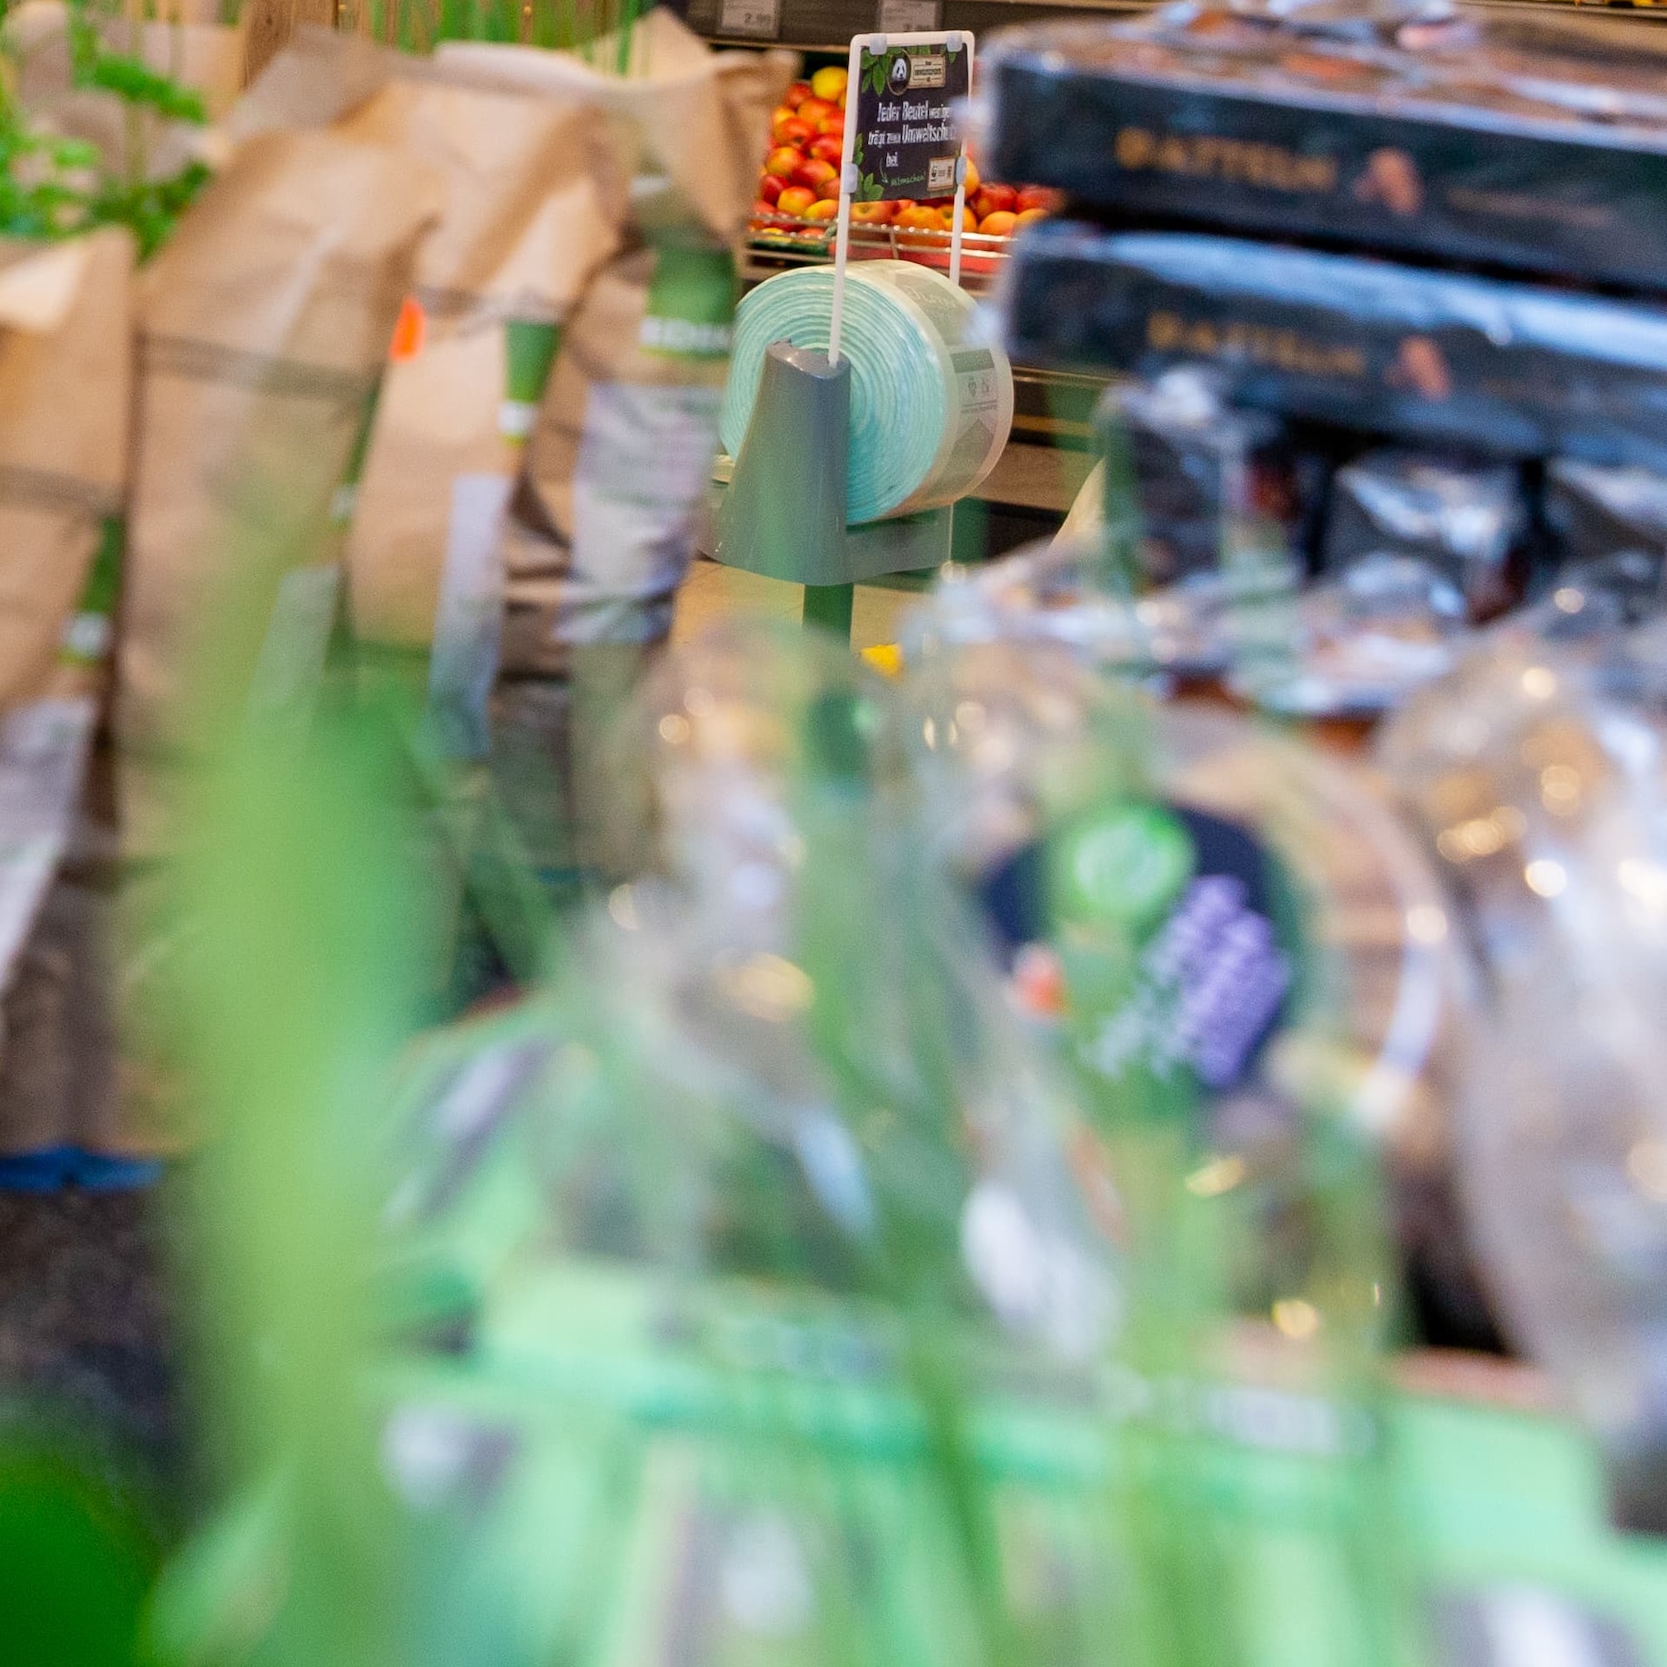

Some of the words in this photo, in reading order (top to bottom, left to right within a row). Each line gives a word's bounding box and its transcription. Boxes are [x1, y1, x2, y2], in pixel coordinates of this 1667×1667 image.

[877, 102, 901, 123] Jeder
[902, 100, 929, 121] Beutel
[868, 130, 886, 149] trägt
